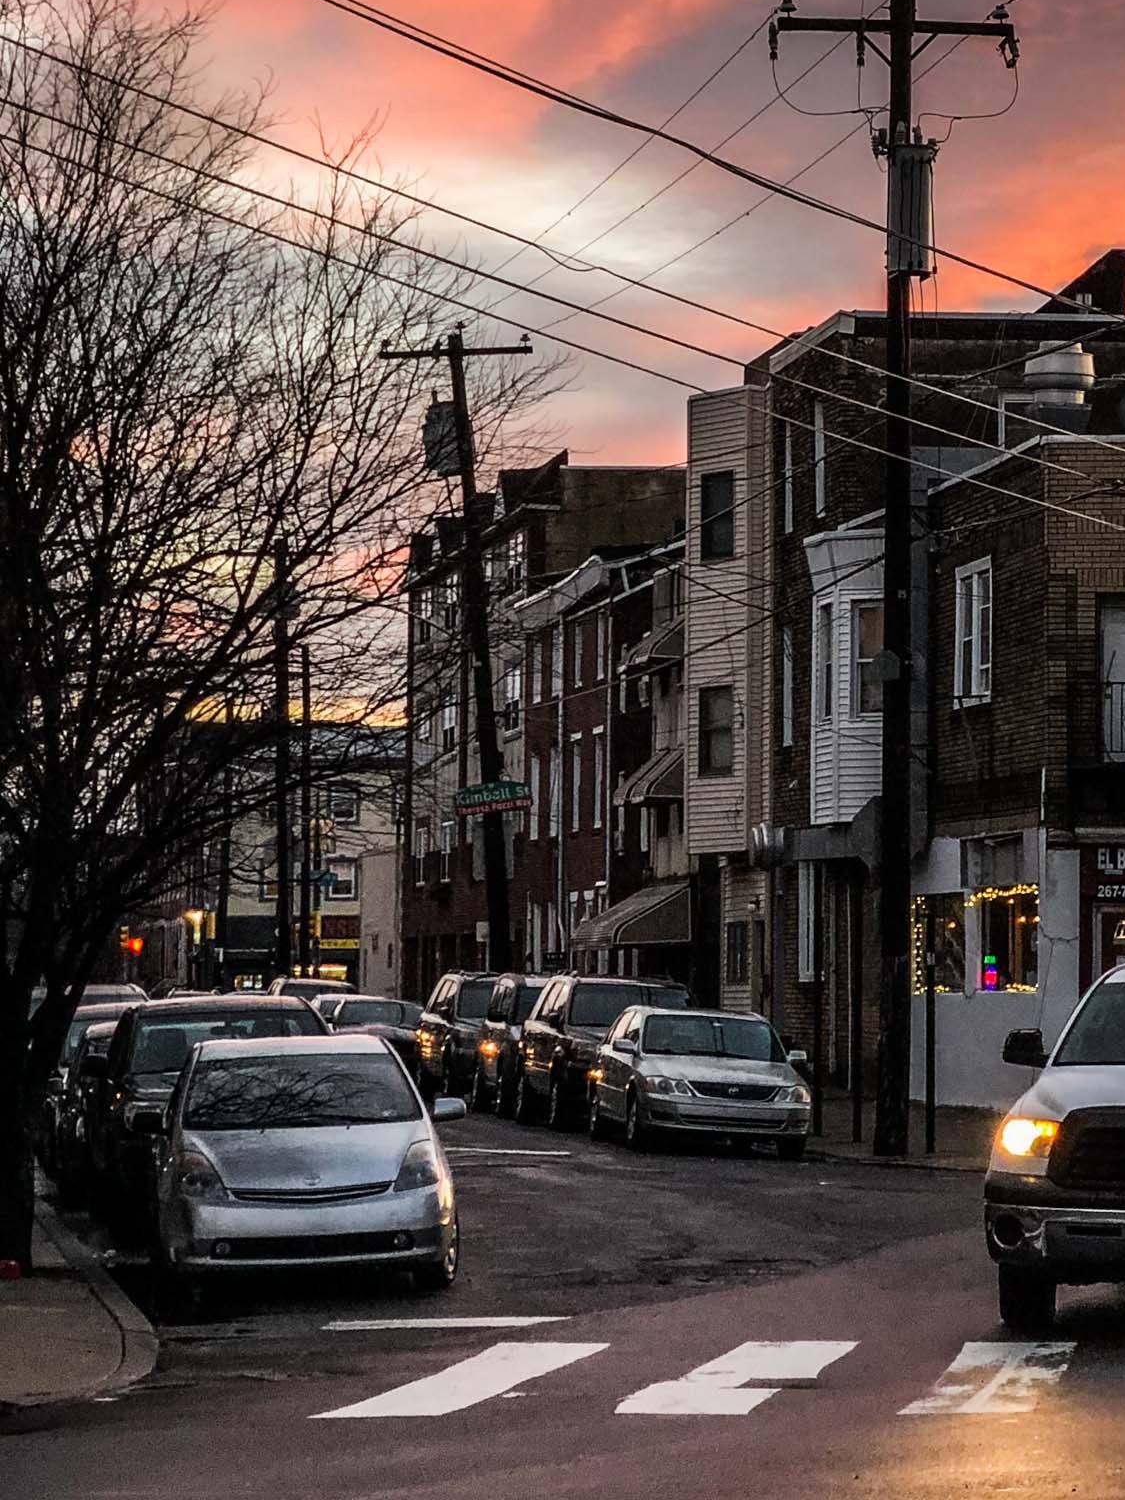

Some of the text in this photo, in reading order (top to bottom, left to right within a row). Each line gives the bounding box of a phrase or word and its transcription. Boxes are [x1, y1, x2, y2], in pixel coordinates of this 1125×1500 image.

[456, 786, 530, 805] Kimball St
[1097, 847, 1114, 870] EL
